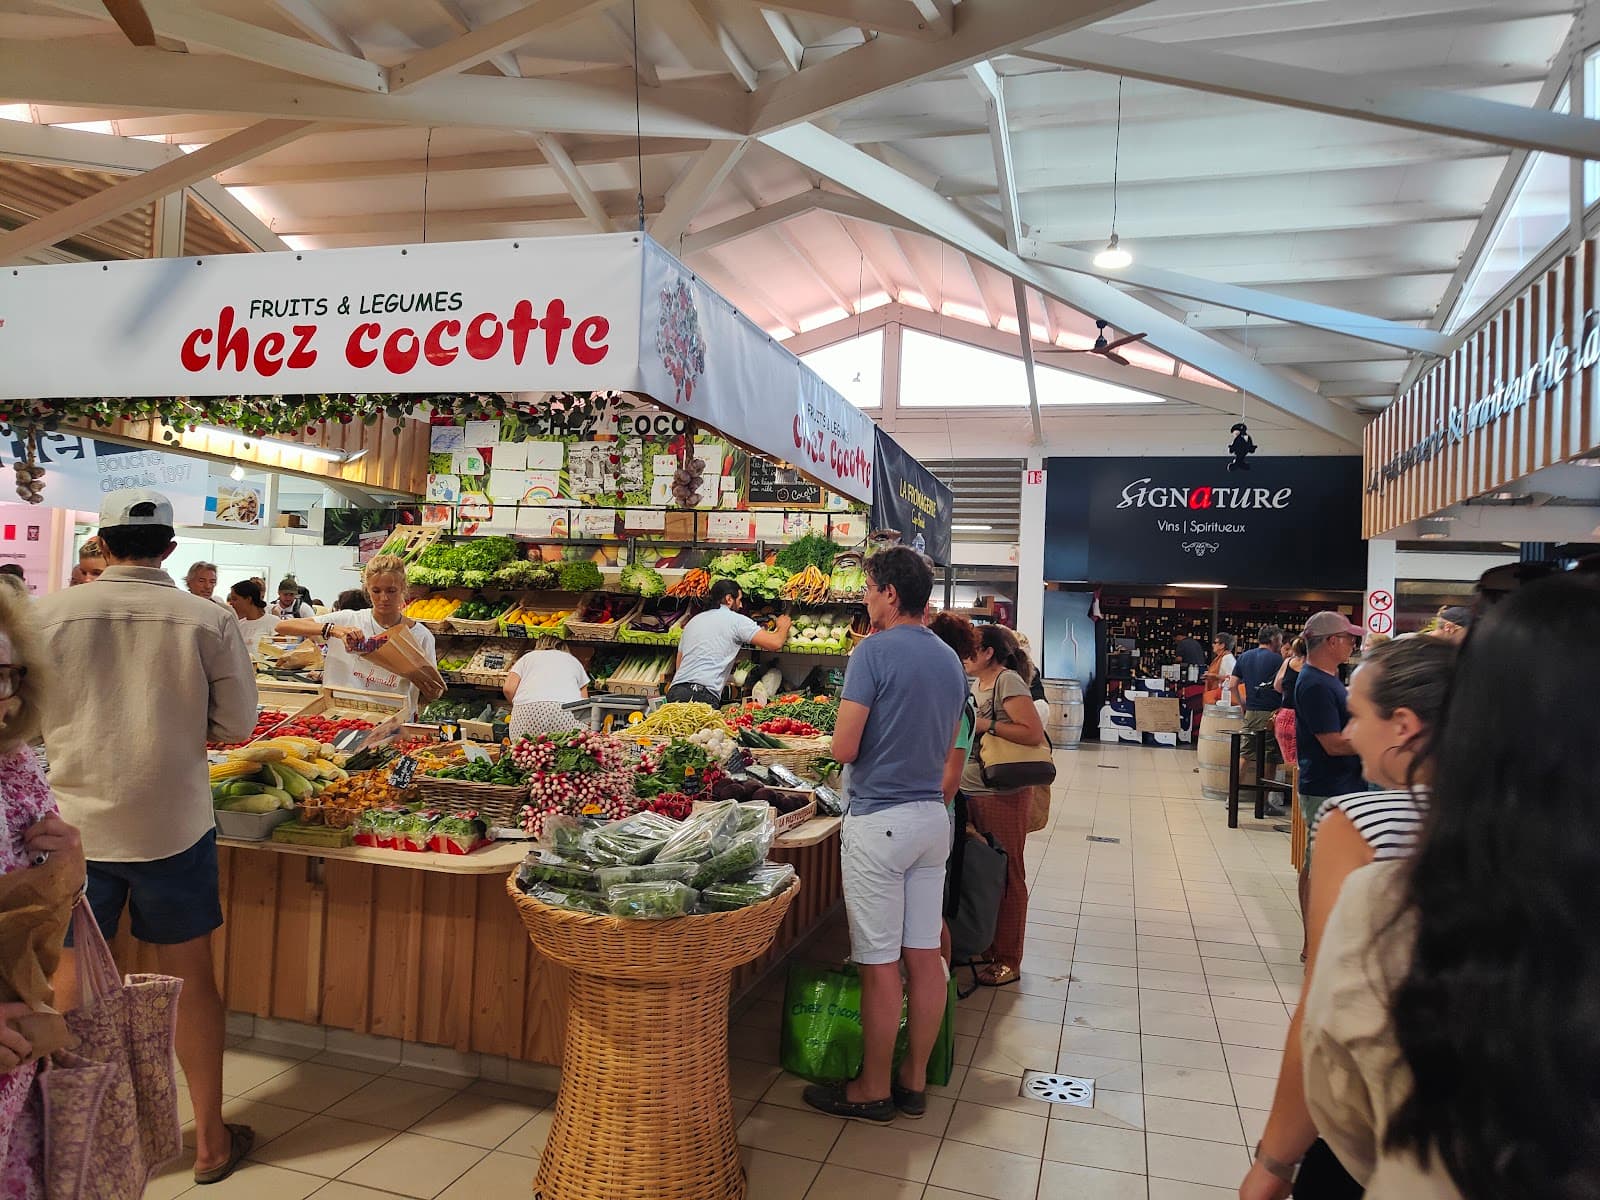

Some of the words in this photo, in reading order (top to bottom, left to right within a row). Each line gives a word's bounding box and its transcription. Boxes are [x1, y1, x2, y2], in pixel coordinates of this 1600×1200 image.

[249, 298, 328, 319] FRUITS
[337, 303, 351, 316] &
[359, 290, 463, 316] LEGUMES
[180, 305, 319, 377] chez
[344, 298, 611, 375] cocotte
[1466, 362, 1541, 436] traiteur
[1541, 328, 1570, 392] de
[1157, 519, 1180, 533] Vins
[1190, 520, 1246, 535] Spiritueux
